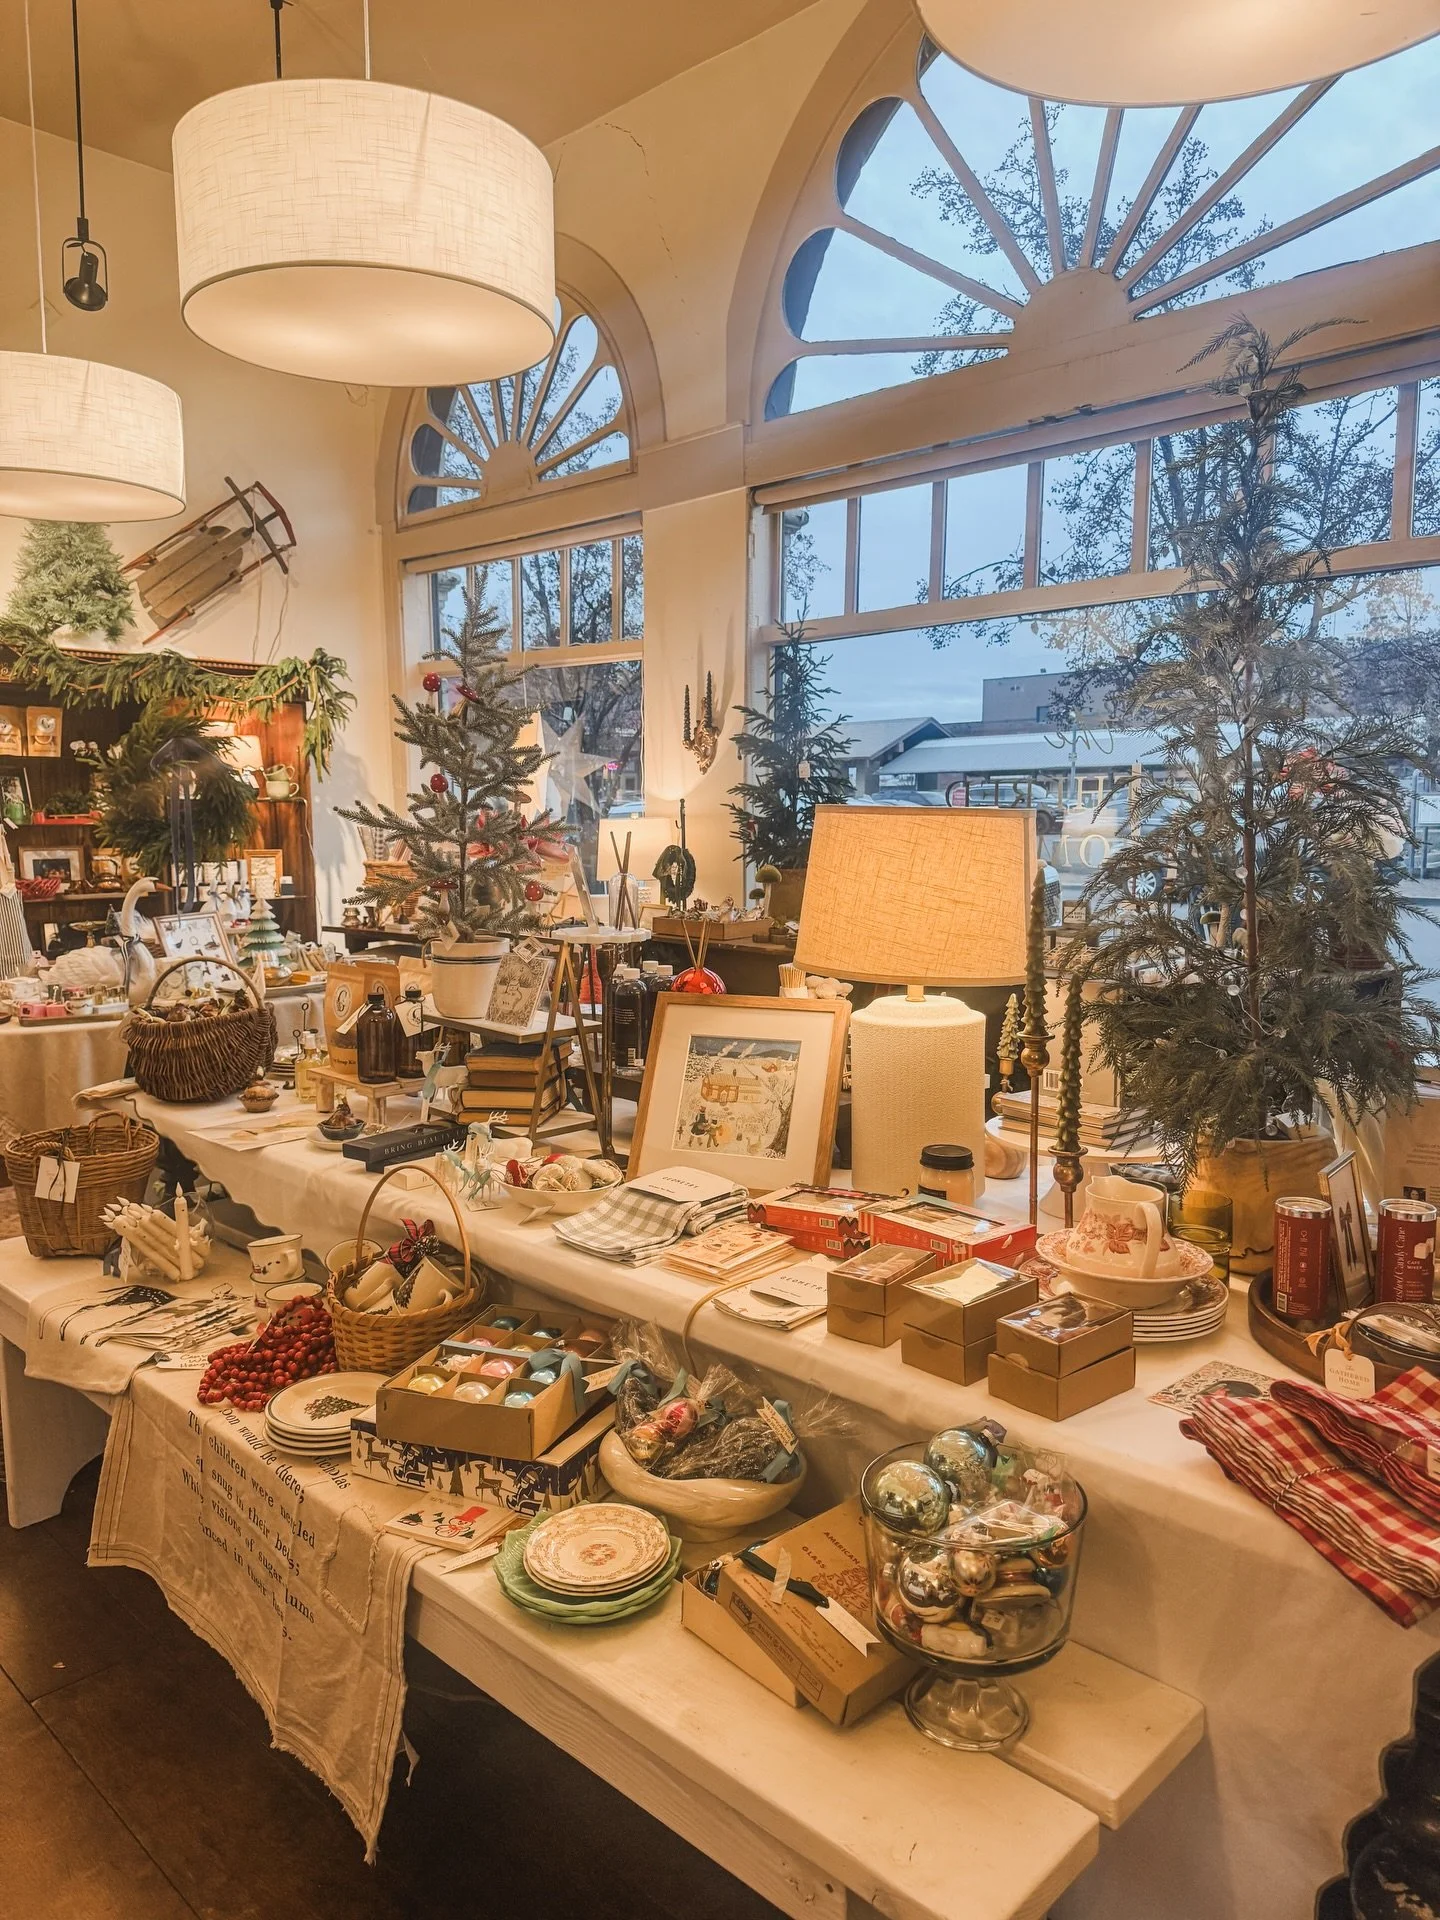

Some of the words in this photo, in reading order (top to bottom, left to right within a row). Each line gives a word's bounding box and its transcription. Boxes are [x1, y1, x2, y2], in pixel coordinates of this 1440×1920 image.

[384, 1142, 413, 1156] BRING
[417, 1130, 451, 1147] BEAUTY
[662, 1176, 699, 1189] GEOMETRY
[1395, 1225, 1406, 1249] Cane
[1393, 1246, 1409, 1277] Candy
[1329, 1367, 1370, 1384] GATHERED
[1338, 1376, 1361, 1388] HOME
[188, 1410, 203, 1435] Th
[208, 1435, 247, 1480] children
[251, 1477, 274, 1507] were
[219, 1408, 240, 1425] oon
[239, 1426, 269, 1450] would
[260, 1449, 277, 1465] be
[275, 1463, 305, 1504] there;
[314, 1455, 351, 1489] icholas
[211, 1469, 233, 1500] snug
[236, 1493, 244, 1510] in
[248, 1506, 270, 1539] their
[211, 1499, 242, 1537] visions
[245, 1537, 255, 1552] of
[801, 1545, 826, 1569] GLASS
[823, 1530, 860, 1565] AMERICAN
[233, 1547, 244, 1567] in
[247, 1564, 267, 1596] their
